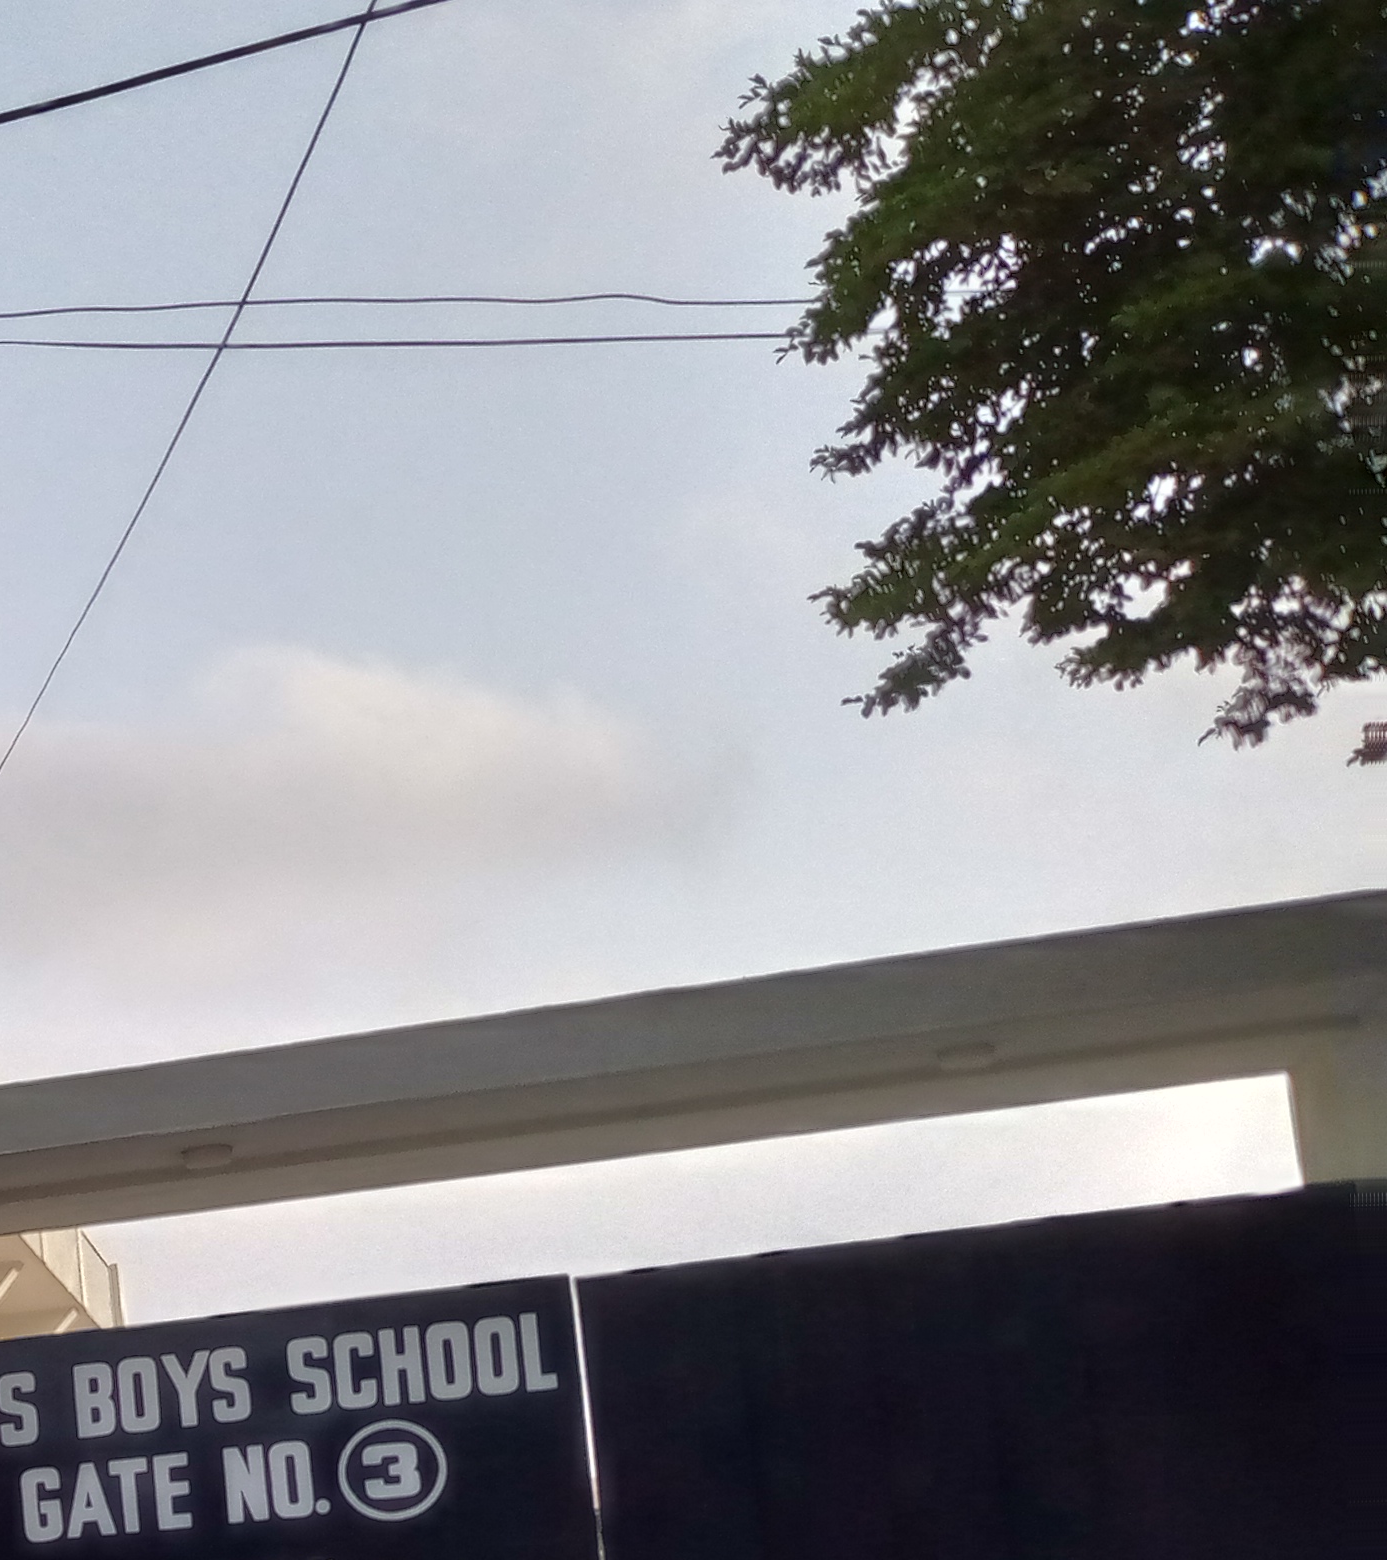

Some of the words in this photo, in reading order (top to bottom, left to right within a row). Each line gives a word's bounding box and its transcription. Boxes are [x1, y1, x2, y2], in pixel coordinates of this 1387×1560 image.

[71, 1345, 253, 1440] BOYS
[284, 1311, 560, 1416] SCHOOL
[18, 1451, 194, 1544] GATE
[220, 1438, 332, 1525] NO.
[360, 1440, 423, 1500] 3
